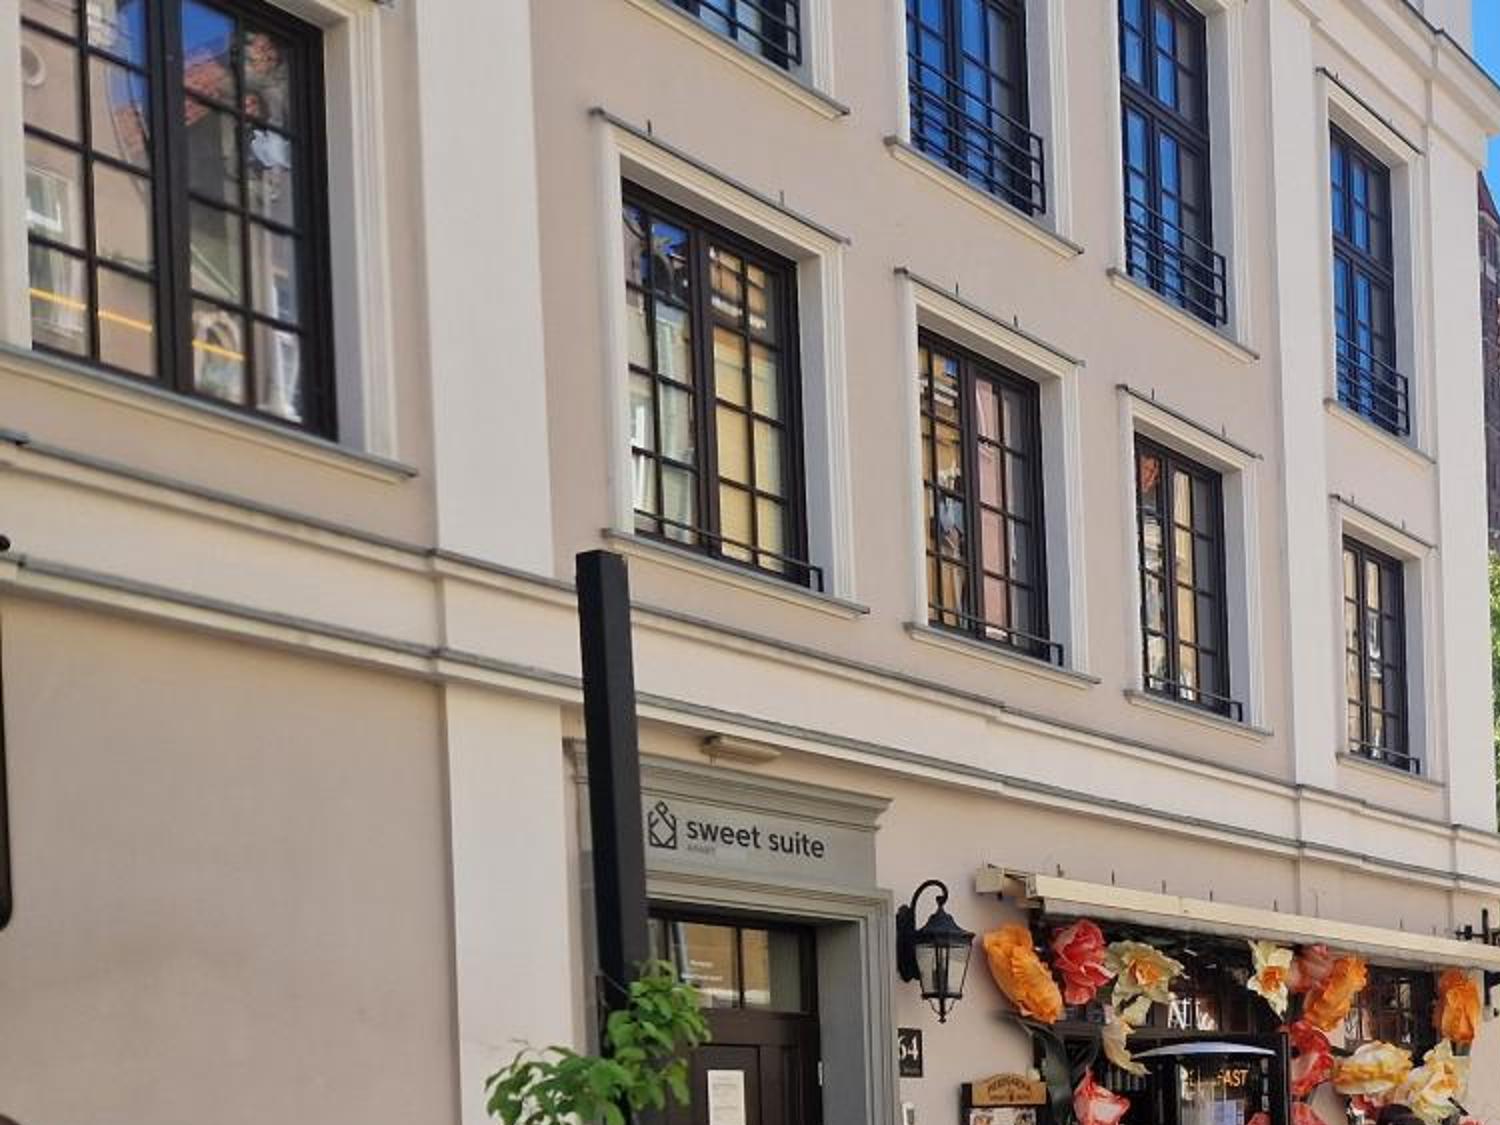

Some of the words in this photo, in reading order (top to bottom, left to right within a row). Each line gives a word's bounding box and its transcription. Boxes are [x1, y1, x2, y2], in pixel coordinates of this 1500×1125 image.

[687, 820, 762, 849] sweet
[768, 831, 825, 859] suite
[897, 1035, 919, 1060] 64
